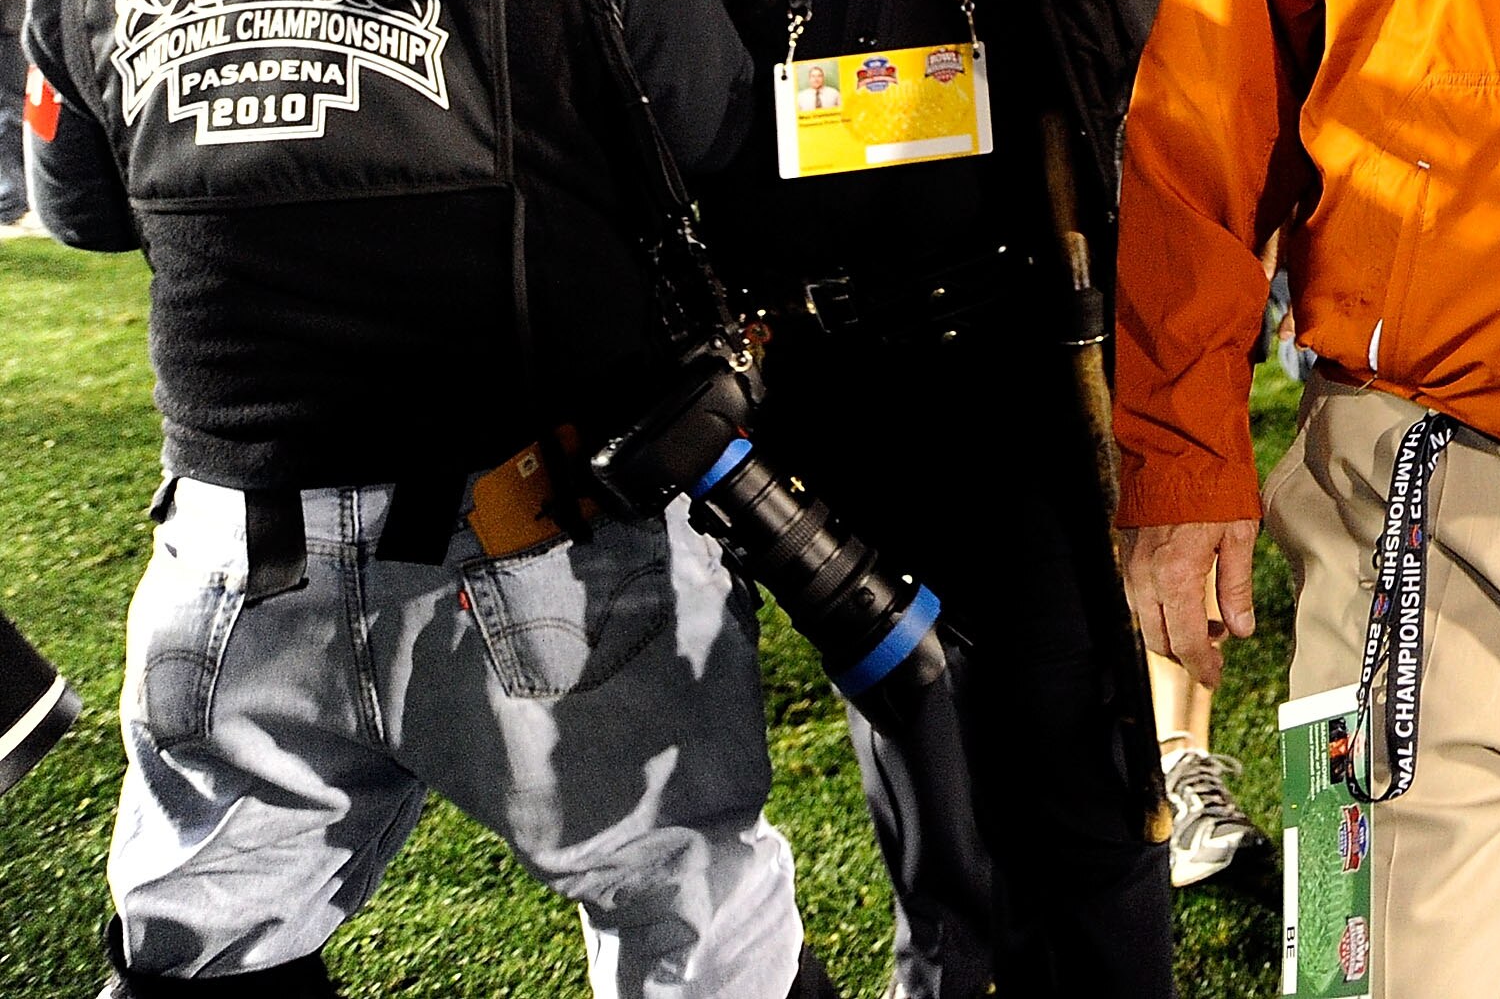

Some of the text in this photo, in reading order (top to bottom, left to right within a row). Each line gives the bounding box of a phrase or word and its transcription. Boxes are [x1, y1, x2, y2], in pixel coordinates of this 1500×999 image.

[236, 9, 427, 66] CHAMPIONSHIP
[182, 59, 345, 96] PASADENA
[211, 93, 306, 127] 2010
[1381, 421, 1426, 590] CHAMPIONSHIP
[1362, 623, 1382, 682] 2010
[1394, 553, 1421, 739] CHAMPIONSHIP
[1286, 926, 1296, 959] BE
